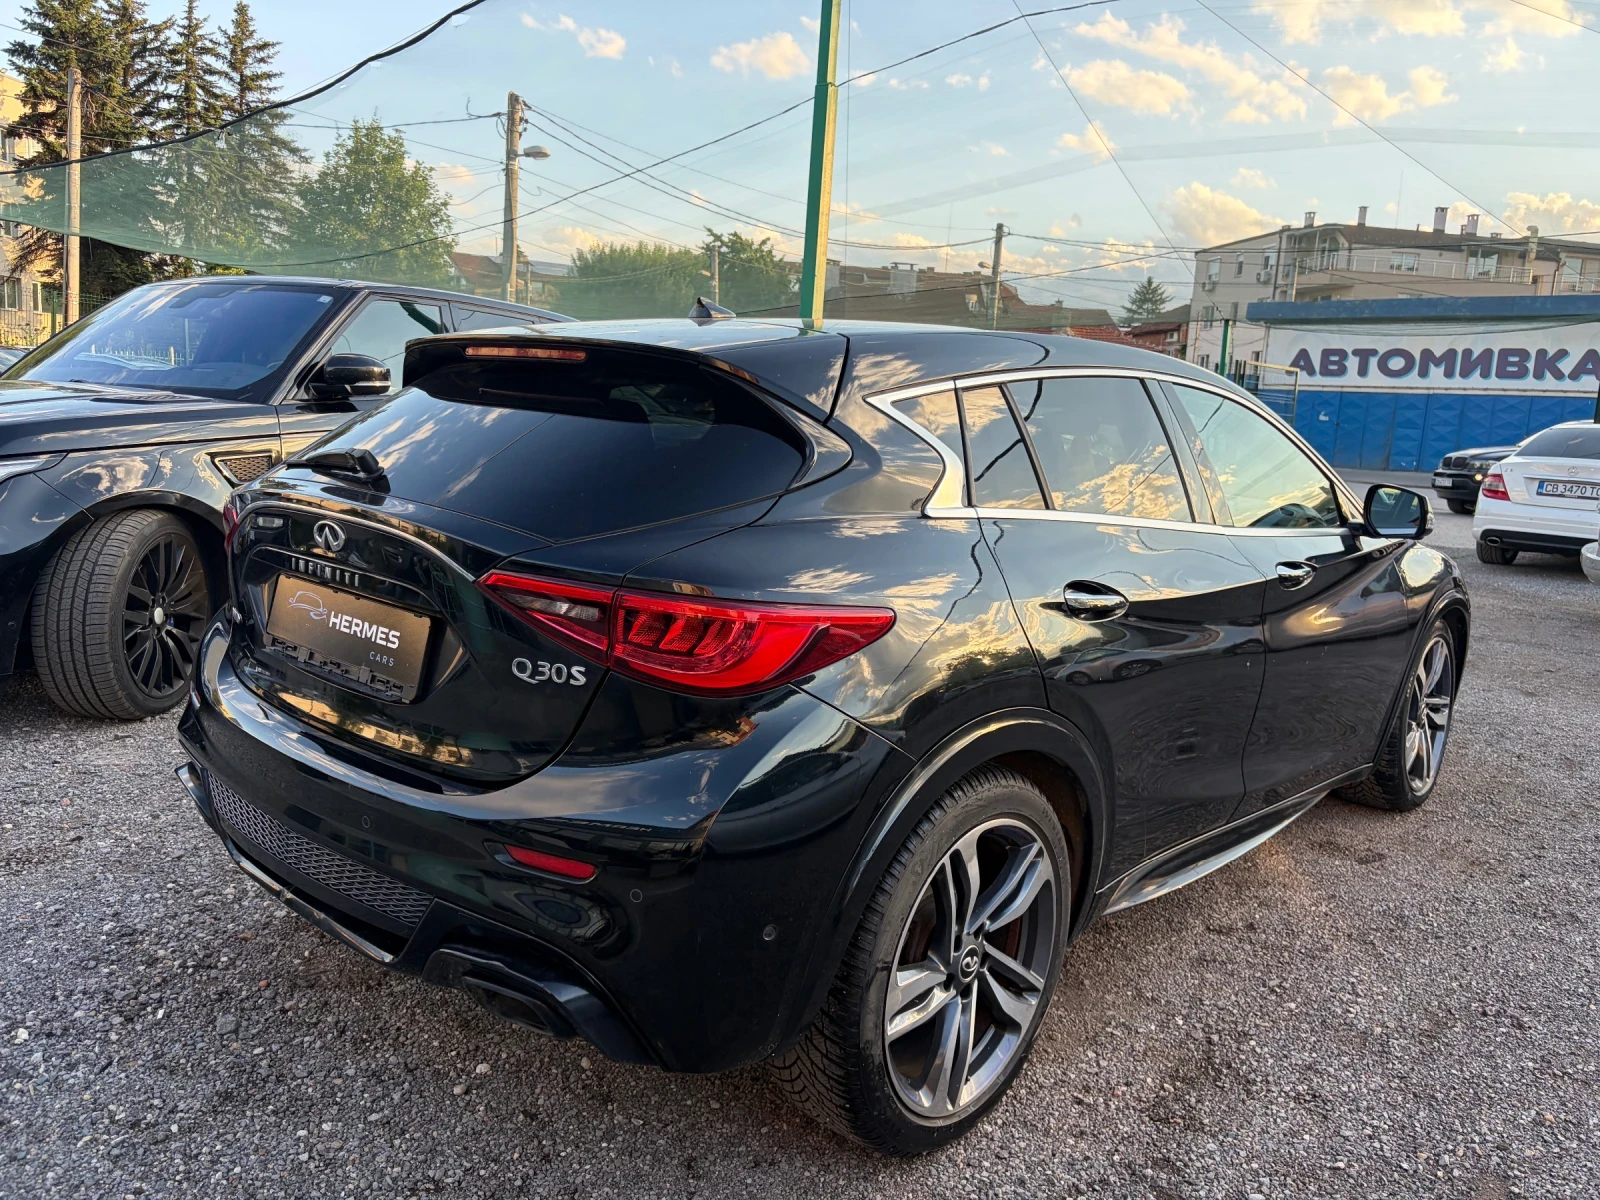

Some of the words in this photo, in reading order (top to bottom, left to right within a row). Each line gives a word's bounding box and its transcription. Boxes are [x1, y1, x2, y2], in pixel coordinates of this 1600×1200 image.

[1285, 348, 1600, 382] АВТОМИВКА
[1560, 484, 1588, 496] 3470
[291, 557, 359, 587] INFINITI
[328, 610, 401, 649] HERMES
[369, 651, 395, 667] CARS
